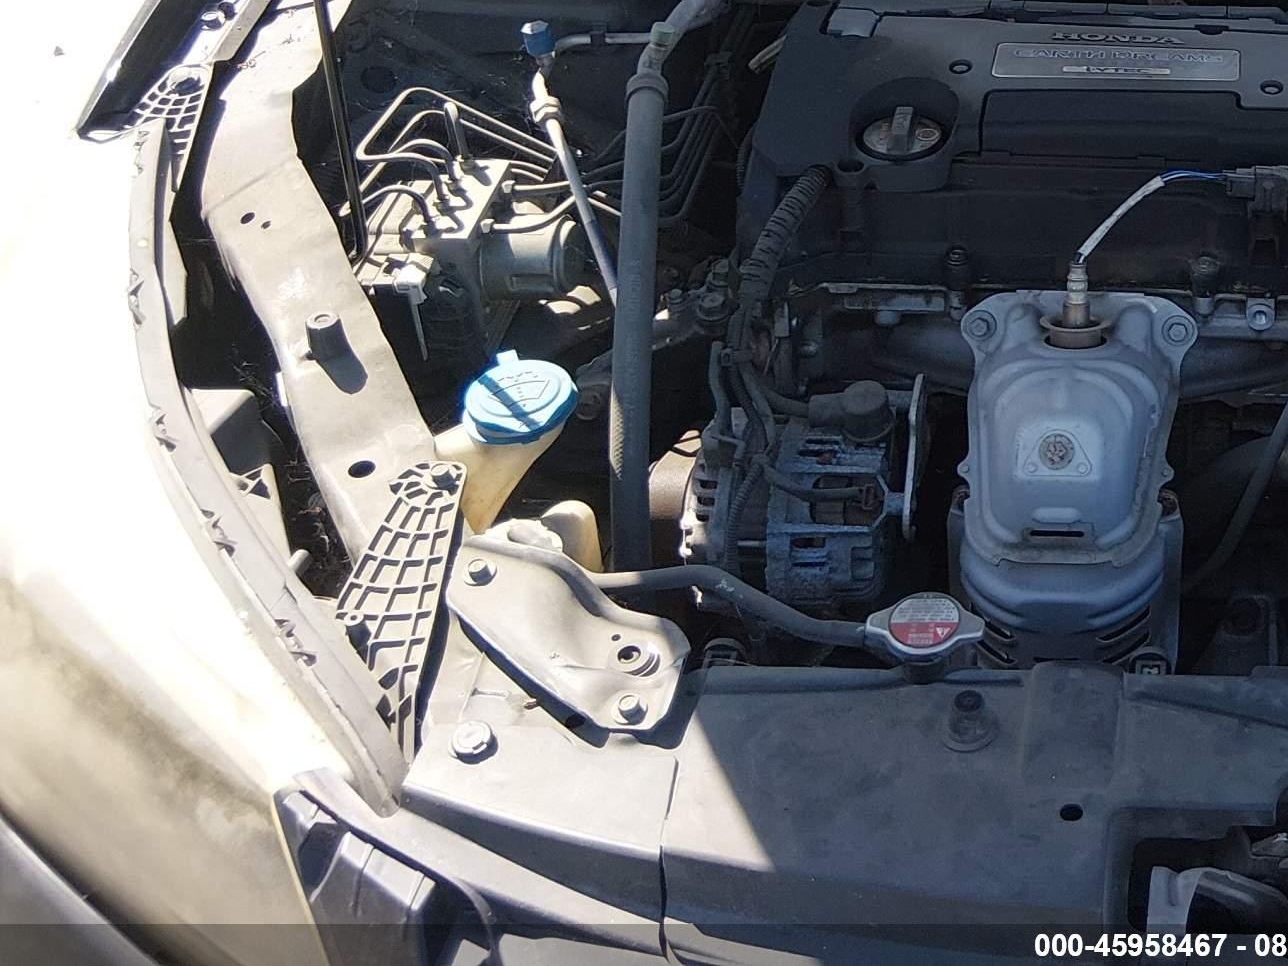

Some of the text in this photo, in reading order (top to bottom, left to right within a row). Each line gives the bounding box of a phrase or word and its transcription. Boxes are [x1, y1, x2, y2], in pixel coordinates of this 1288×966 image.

[1052, 31, 1185, 45] HONDA
[1014, 48, 1224, 63] EARTH DREAMS
